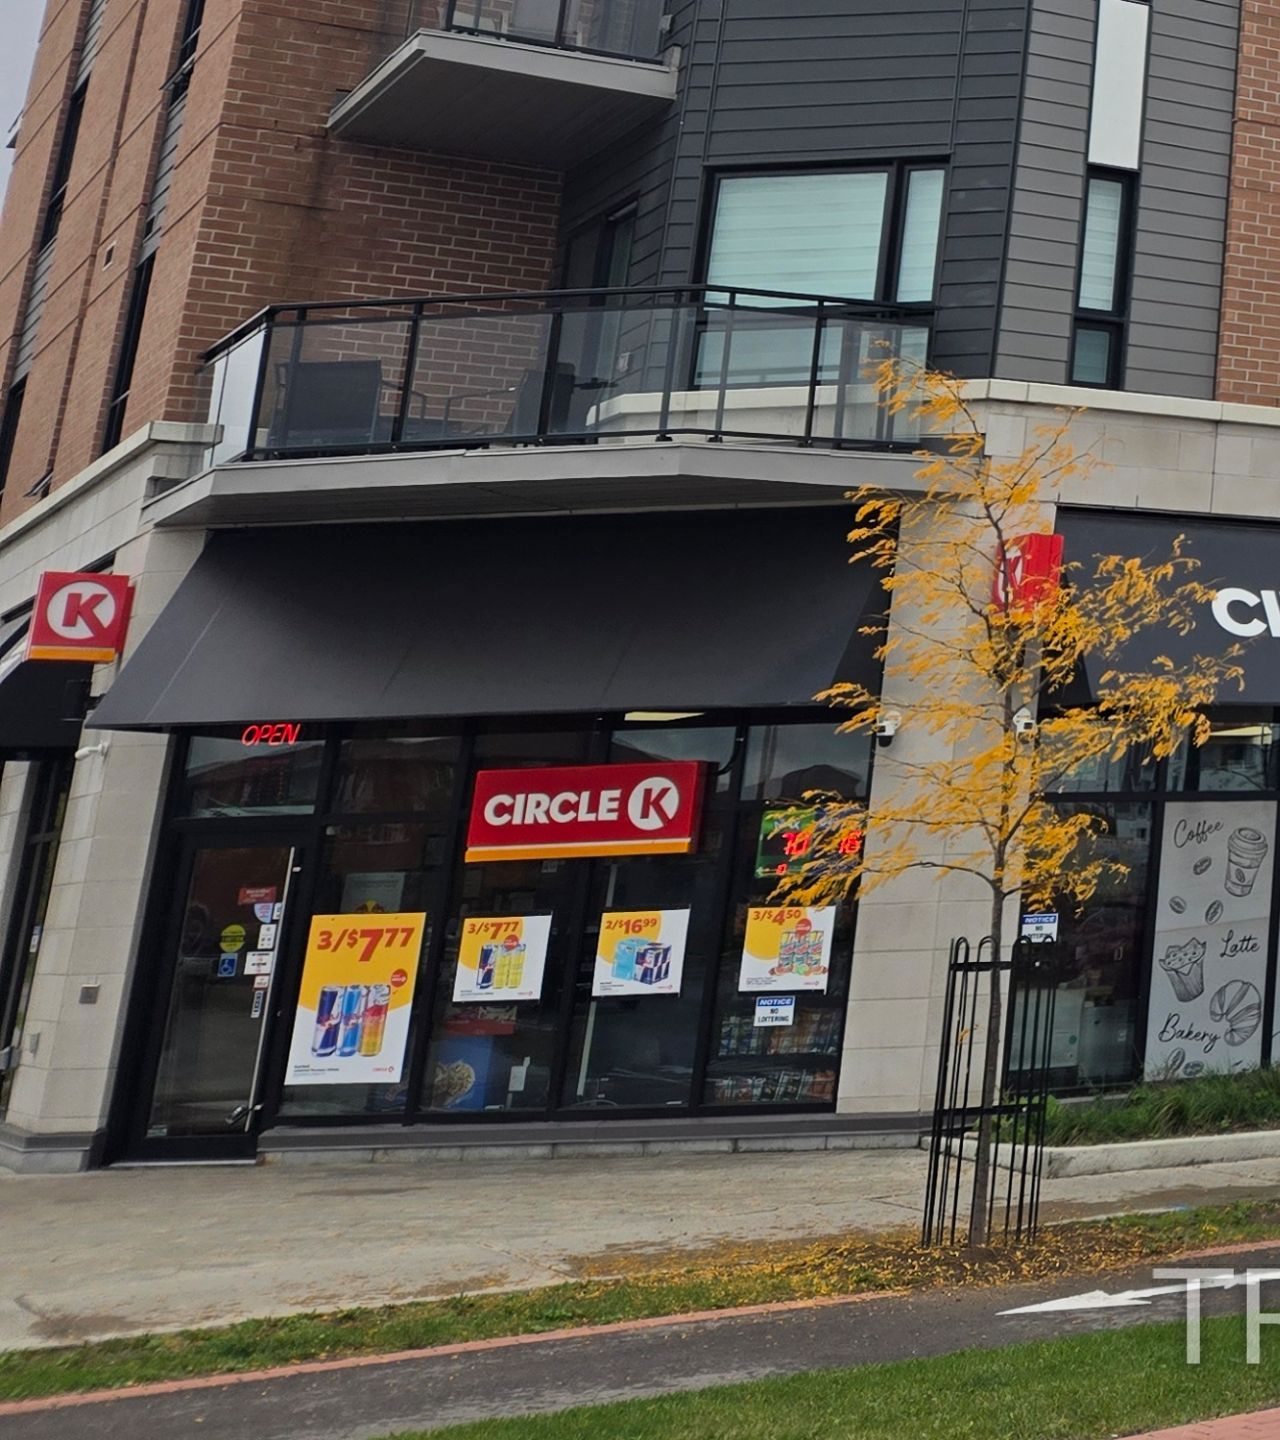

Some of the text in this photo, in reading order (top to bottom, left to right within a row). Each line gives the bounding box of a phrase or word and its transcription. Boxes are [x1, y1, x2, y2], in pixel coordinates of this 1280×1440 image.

[241, 723, 300, 746] OPEN
[484, 782, 676, 829] CIRCLE K
[1173, 819, 1224, 849] Coffee
[1024, 916, 1055, 924] NOTICE
[1219, 929, 1260, 958] Latte
[760, 997, 792, 1006] NOTICE
[758, 1015, 789, 1024] LOITERING
[1158, 1012, 1221, 1054] Bakery
